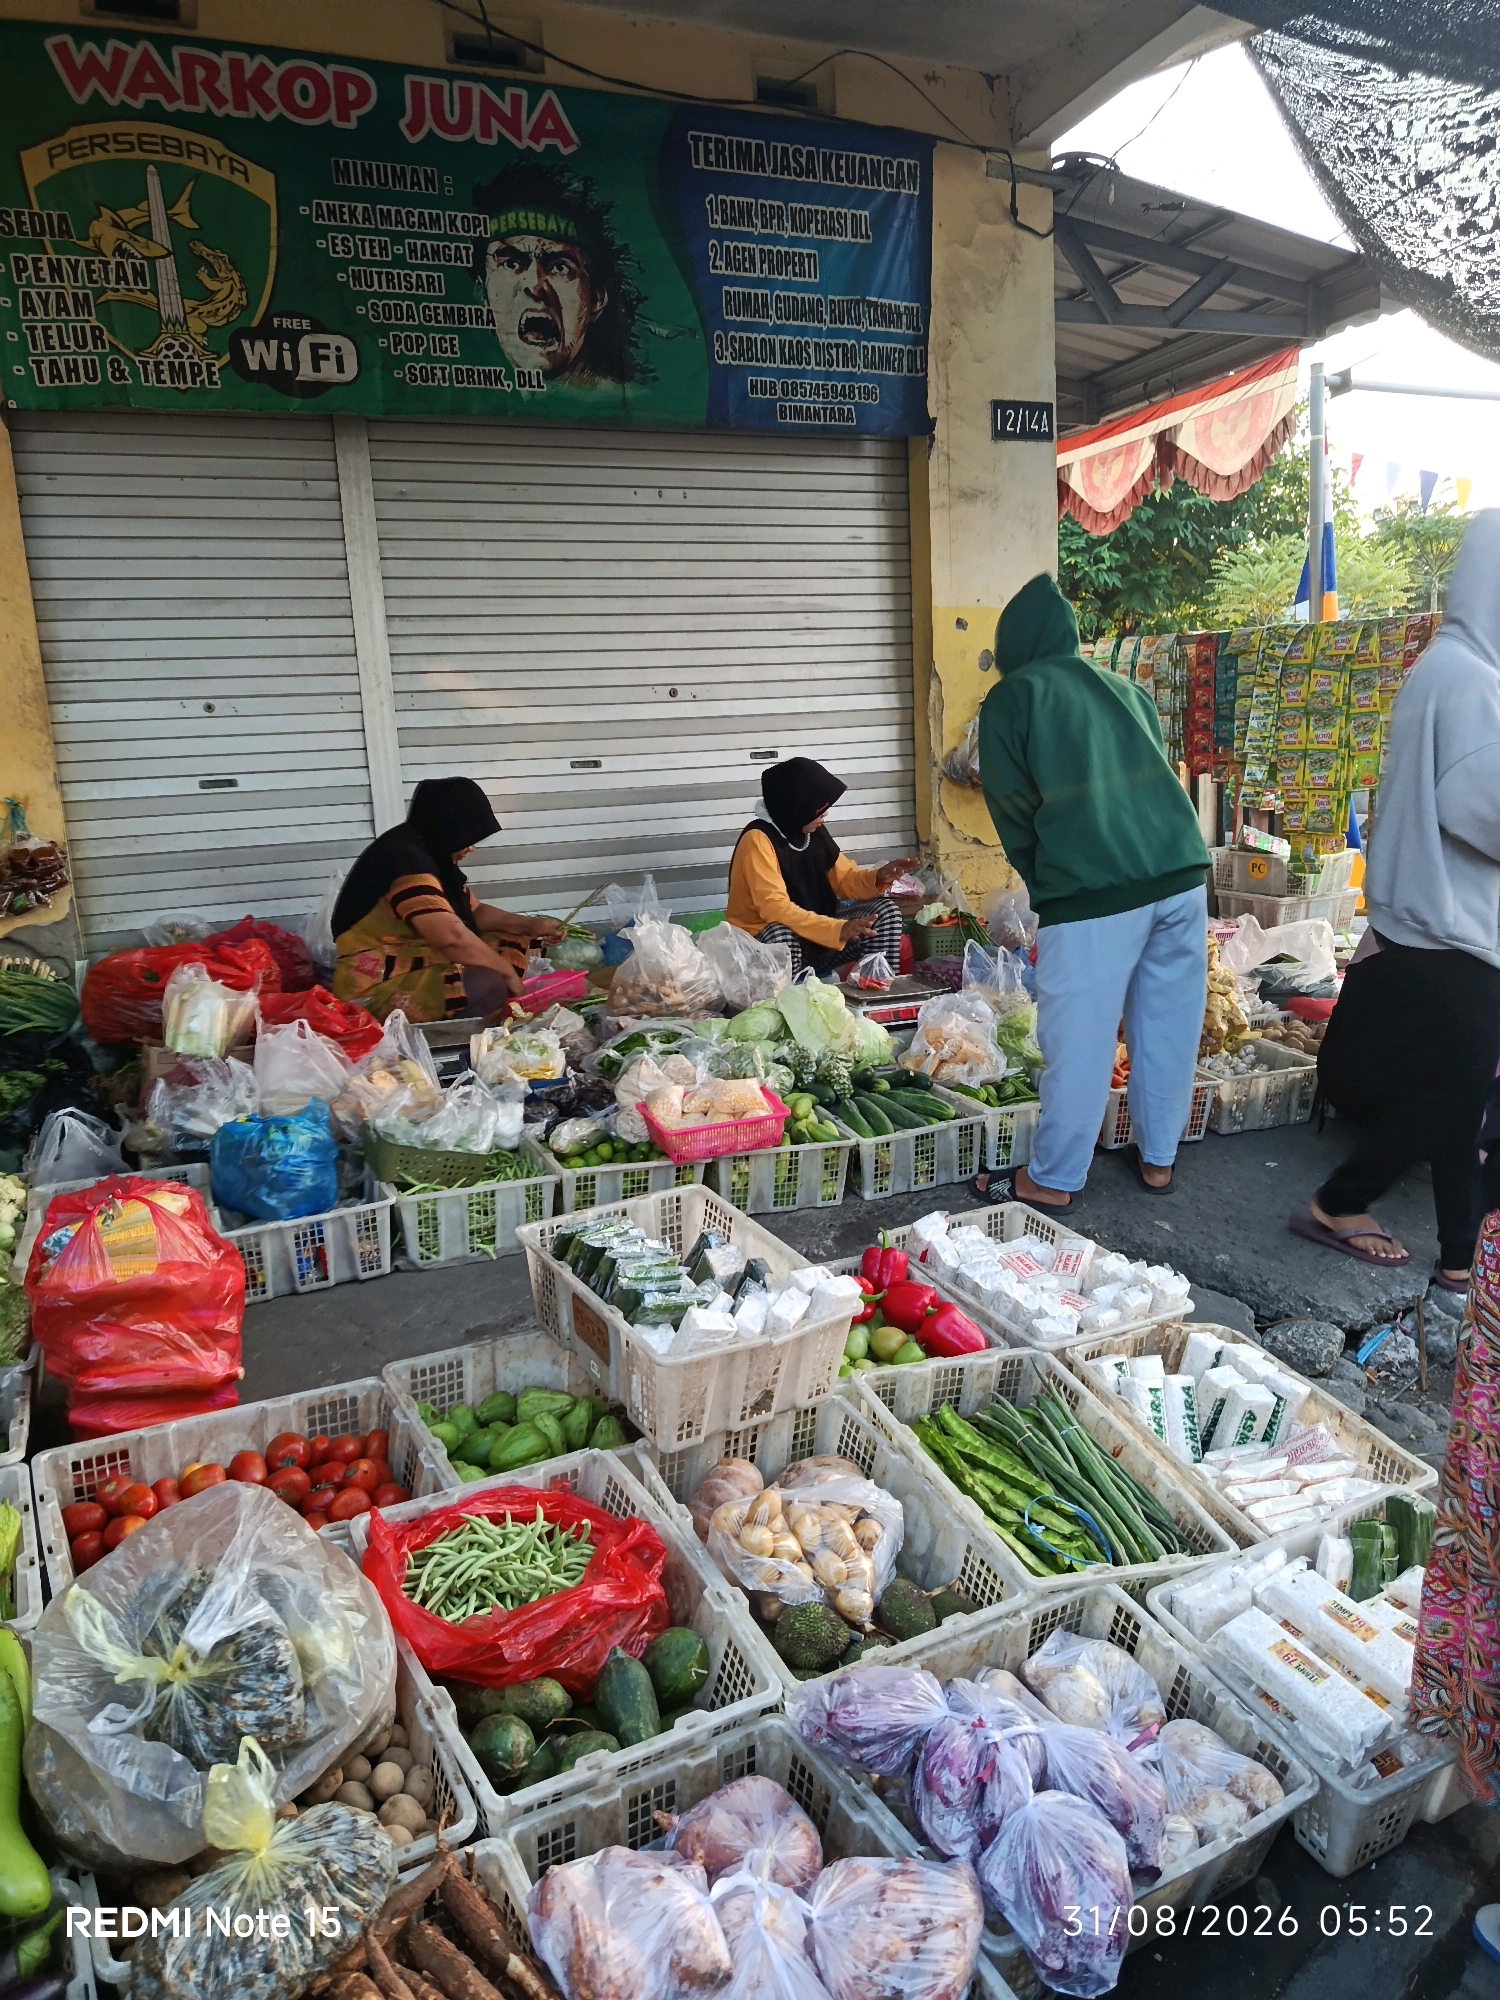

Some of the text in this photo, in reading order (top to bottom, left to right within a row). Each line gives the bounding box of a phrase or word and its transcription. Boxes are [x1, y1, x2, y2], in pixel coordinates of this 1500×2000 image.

[44, 34, 580, 155] WARKOP JUNA
[47, 132, 250, 183] PERSEBAYA
[688, 131, 920, 195] TERIMA JASA KEUANGAN
[332, 158, 438, 194] MINUMAN
[0, 207, 76, 241] SEDIA
[313, 200, 491, 237] ANEKA MACAM KOPI
[490, 211, 577, 238] PERSEBAYA
[718, 195, 759, 235] BANK,
[758, 199, 789, 239] BPR,
[788, 203, 849, 242] KOPERASI
[849, 209, 872, 243] DLL
[328, 234, 354, 258] ES
[355, 236, 392, 260] TEH
[405, 239, 474, 267] HANGAT
[722, 241, 759, 277] AGEN
[759, 244, 819, 282] PROPERTI
[10, 253, 150, 289] PENYETAN
[349, 266, 445, 296] NUTRISARI
[19, 288, 96, 320] AYAM
[368, 299, 497, 329] SODA GEMBIRA
[722, 286, 773, 326] RUMAH,
[773, 290, 828, 330] GUDANG,
[827, 295, 866, 332] RUKO,
[903, 302, 923, 335] DLL
[22, 323, 110, 353] TELUR
[273, 318, 311, 330] FREE
[389, 332, 460, 357] POP ICE
[728, 331, 778, 367] SABLON
[778, 335, 813, 370] KAOS
[812, 338, 861, 373] DISTRO,
[861, 341, 906, 376] BANNER
[906, 345, 926, 377] DLL
[29, 355, 221, 388] TAHU & TEMPE
[405, 363, 547, 392] SOFT DRINK, DLL
[748, 376, 879, 404] HUB 085745948196
[777, 402, 856, 425] BIMANTARA
[1251, 862, 1266, 874] PC
